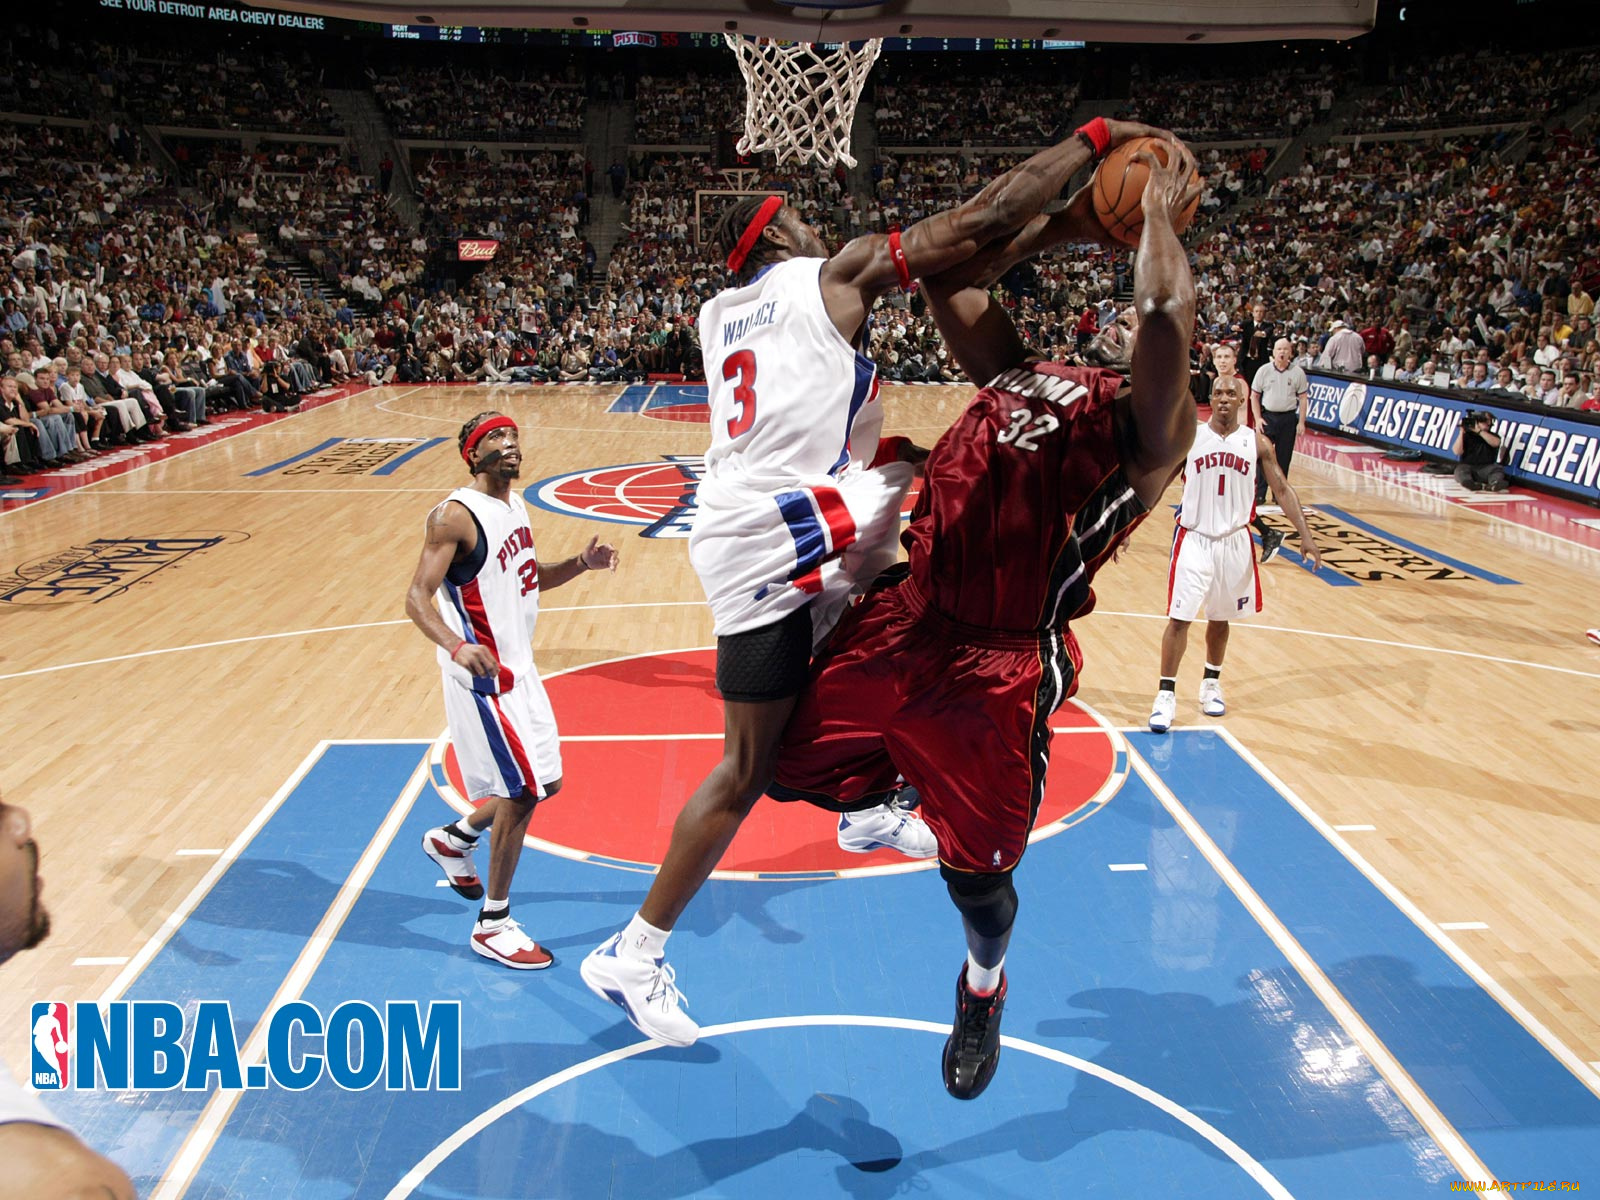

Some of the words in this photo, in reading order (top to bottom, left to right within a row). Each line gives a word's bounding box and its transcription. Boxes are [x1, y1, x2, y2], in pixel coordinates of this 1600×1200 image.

[100, 0, 123, 9] SEE
[126, 0, 156, 13] YOUR
[159, 2, 205, 18] DETROIT
[208, 7, 238, 22] AREA
[240, 10, 276, 26] CHEVY
[278, 14, 325, 30] DEALERS
[613, 32, 657, 47] PISTONS
[460, 241, 498, 257] Bud
[722, 349, 757, 440] 3
[1306, 382, 1345, 405] STERN
[1304, 399, 1338, 423] NALS
[997, 408, 1060, 452] 32
[1363, 395, 1462, 450] EASTERN
[1491, 418, 1600, 488] NFEREN
[1194, 452, 1251, 475] PISTONS
[1218, 474, 1226, 496] 1
